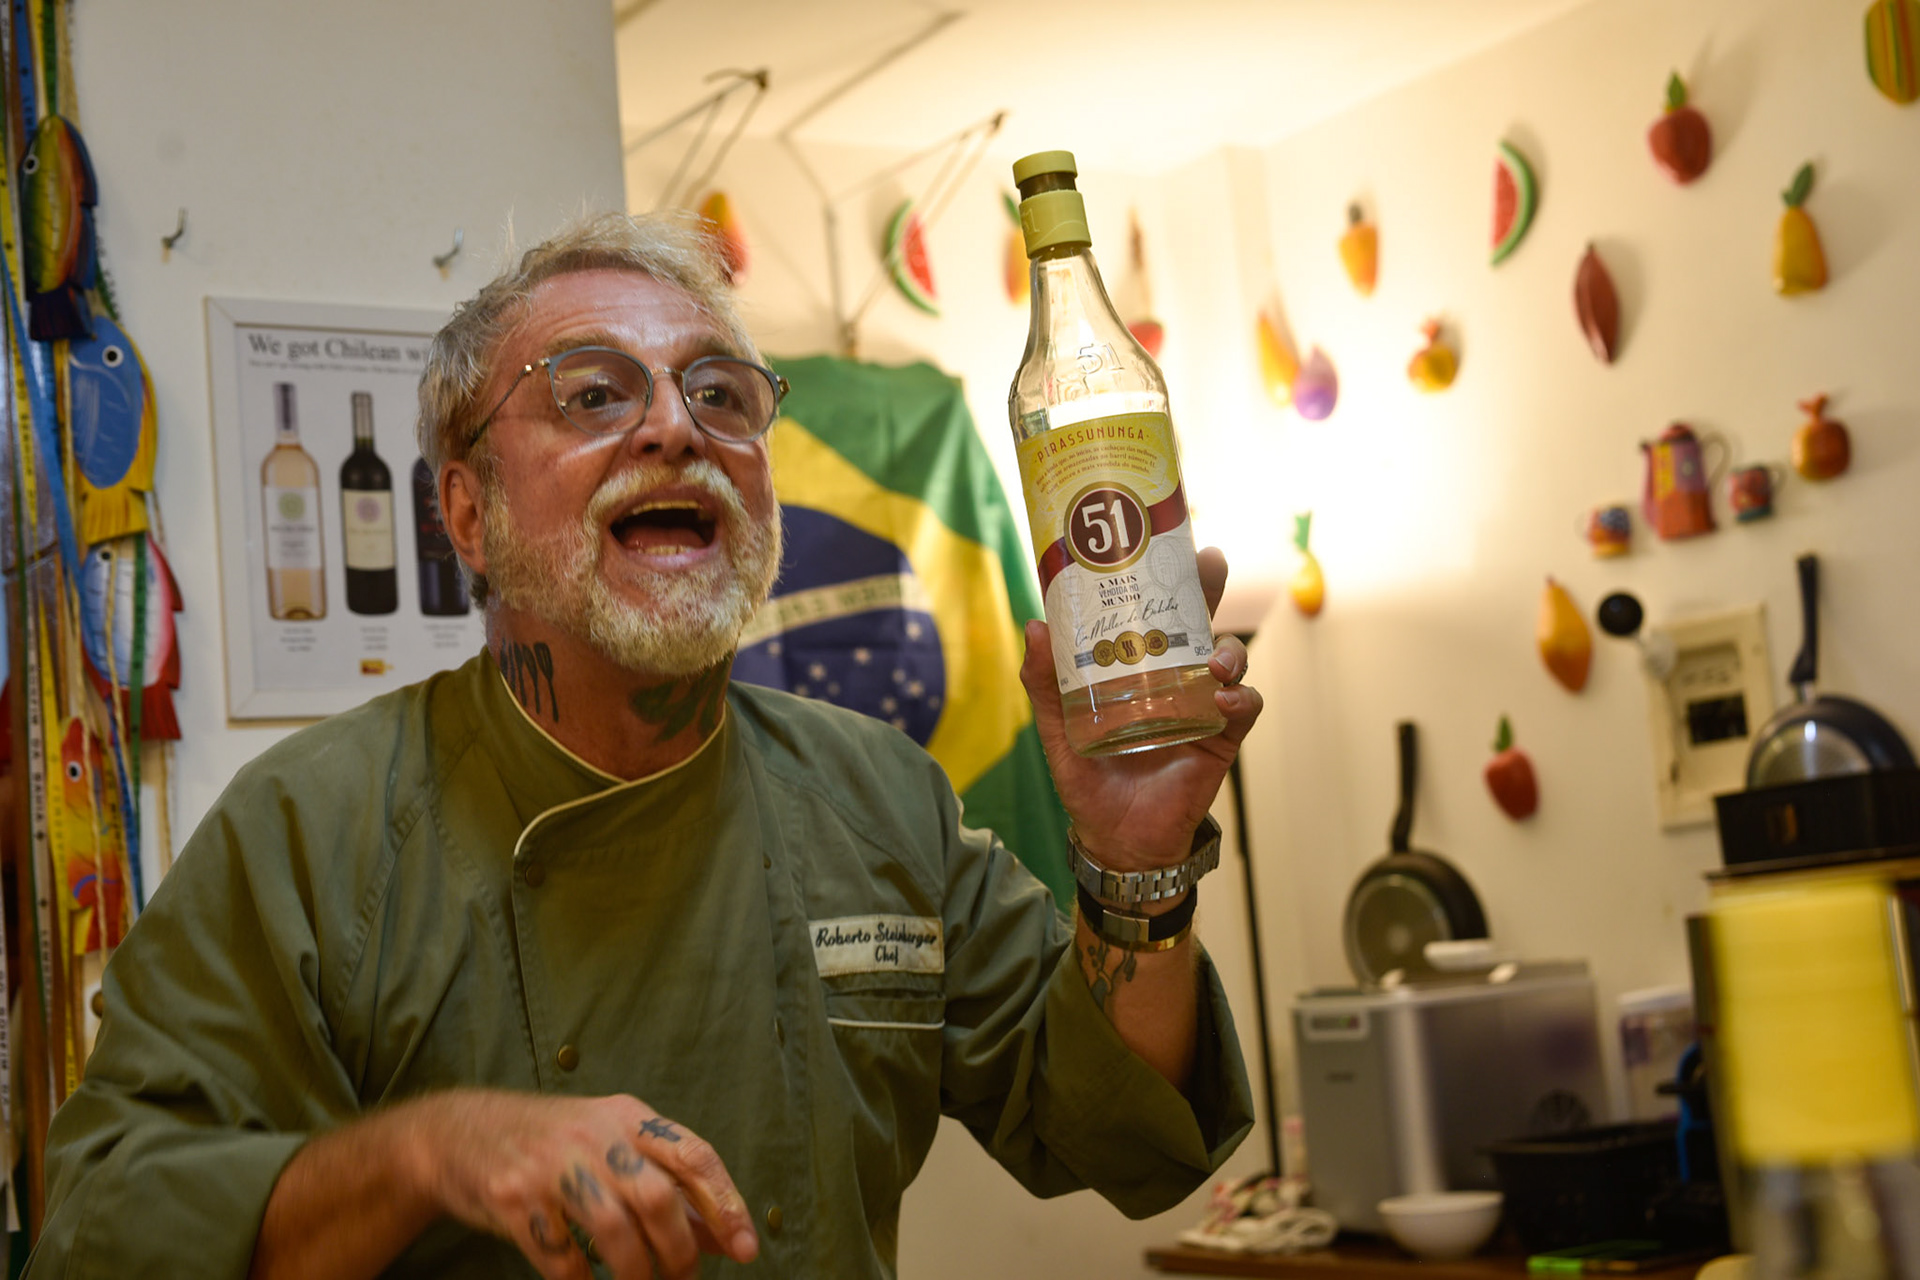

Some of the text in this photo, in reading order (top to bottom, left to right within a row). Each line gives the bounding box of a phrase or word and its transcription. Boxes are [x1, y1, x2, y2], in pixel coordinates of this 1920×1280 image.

[248, 333, 281, 356] We
[287, 340, 319, 362] got
[324, 337, 401, 362] Chilean
[1037, 426, 1144, 463] PIRASSUNUNGA
[1081, 498, 1131, 554] 51
[1098, 573, 1137, 589] A MAIS
[1098, 583, 1140, 599] VENDIDA NO
[1101, 592, 1141, 608] MUNDO
[815, 925, 871, 948] Roberto
[874, 945, 900, 967] Chef
